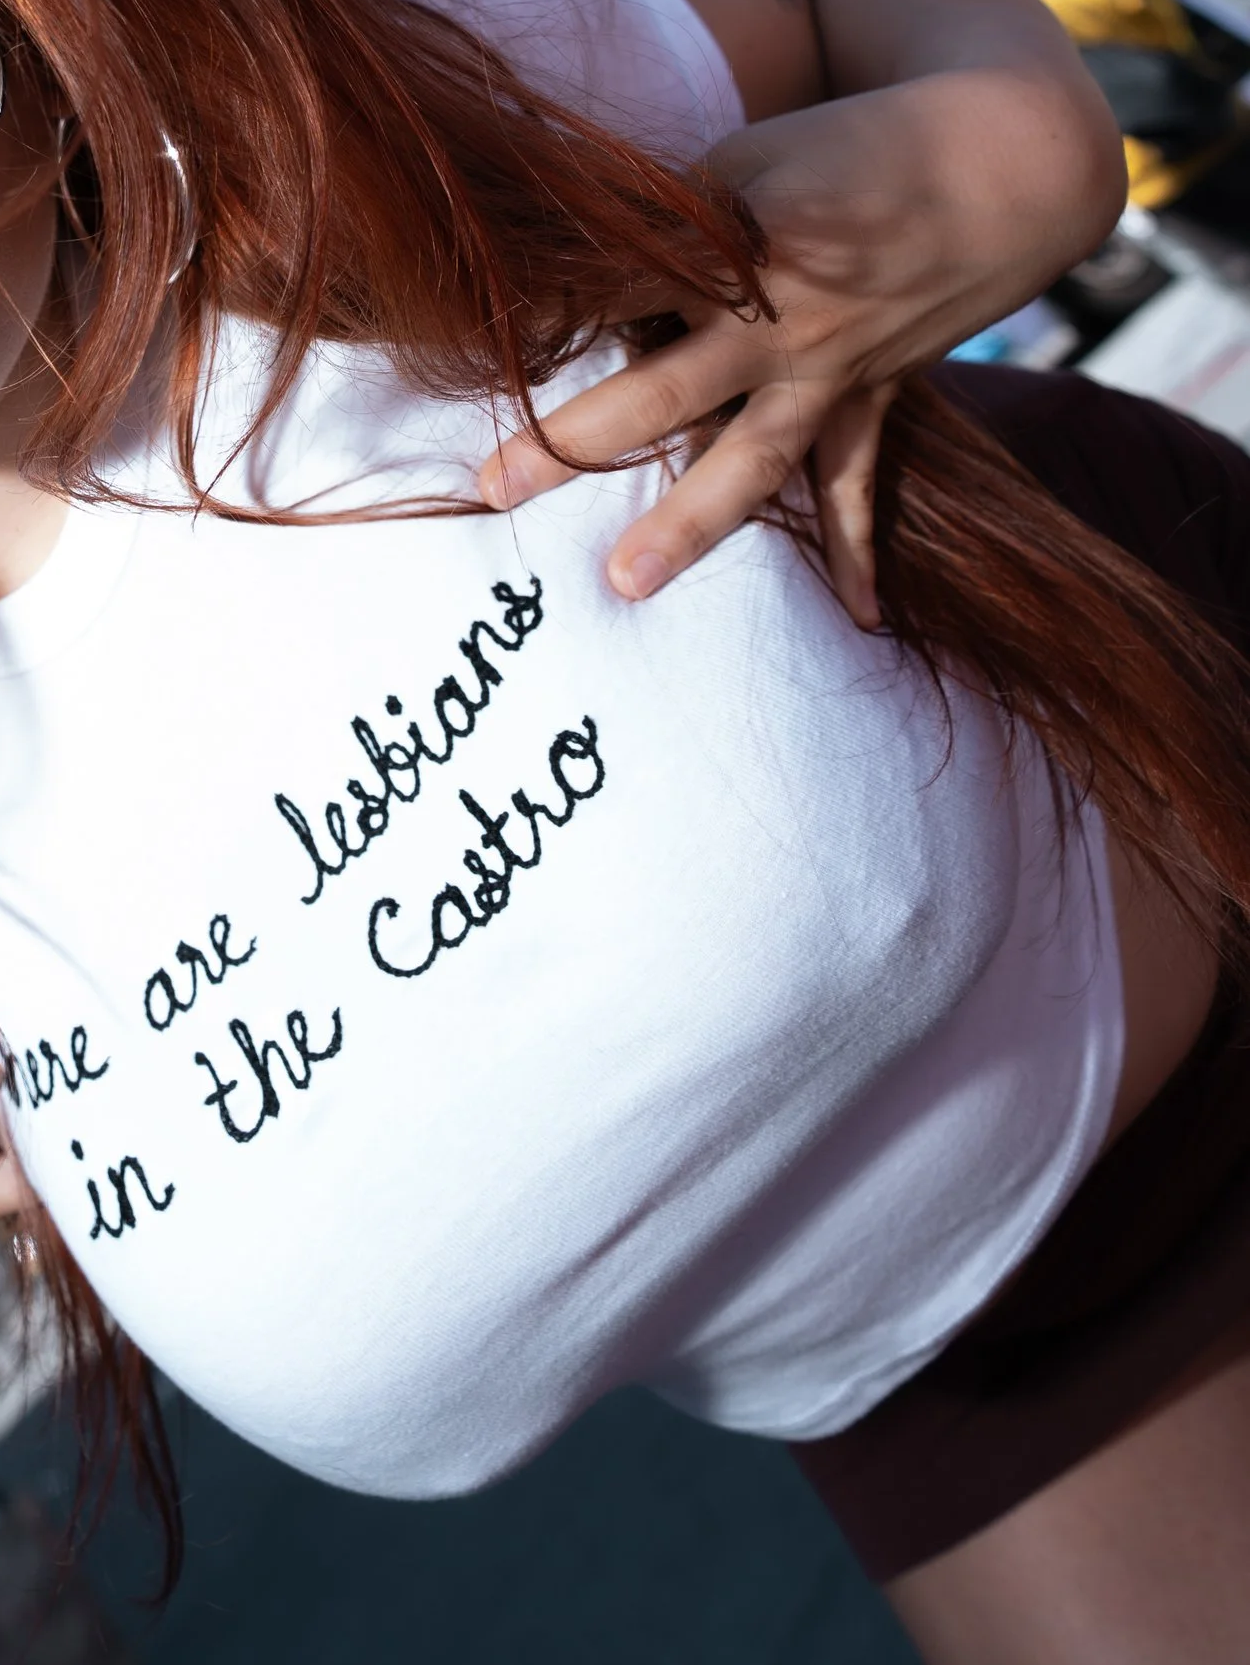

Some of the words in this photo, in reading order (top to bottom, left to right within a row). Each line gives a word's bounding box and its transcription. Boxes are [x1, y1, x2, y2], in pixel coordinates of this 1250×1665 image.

[70, 1138, 176, 1240] in
[193, 1006, 343, 1143] the
[367, 714, 606, 979] Castro
[143, 913, 256, 1032] are
[273, 574, 544, 905] lesbians
